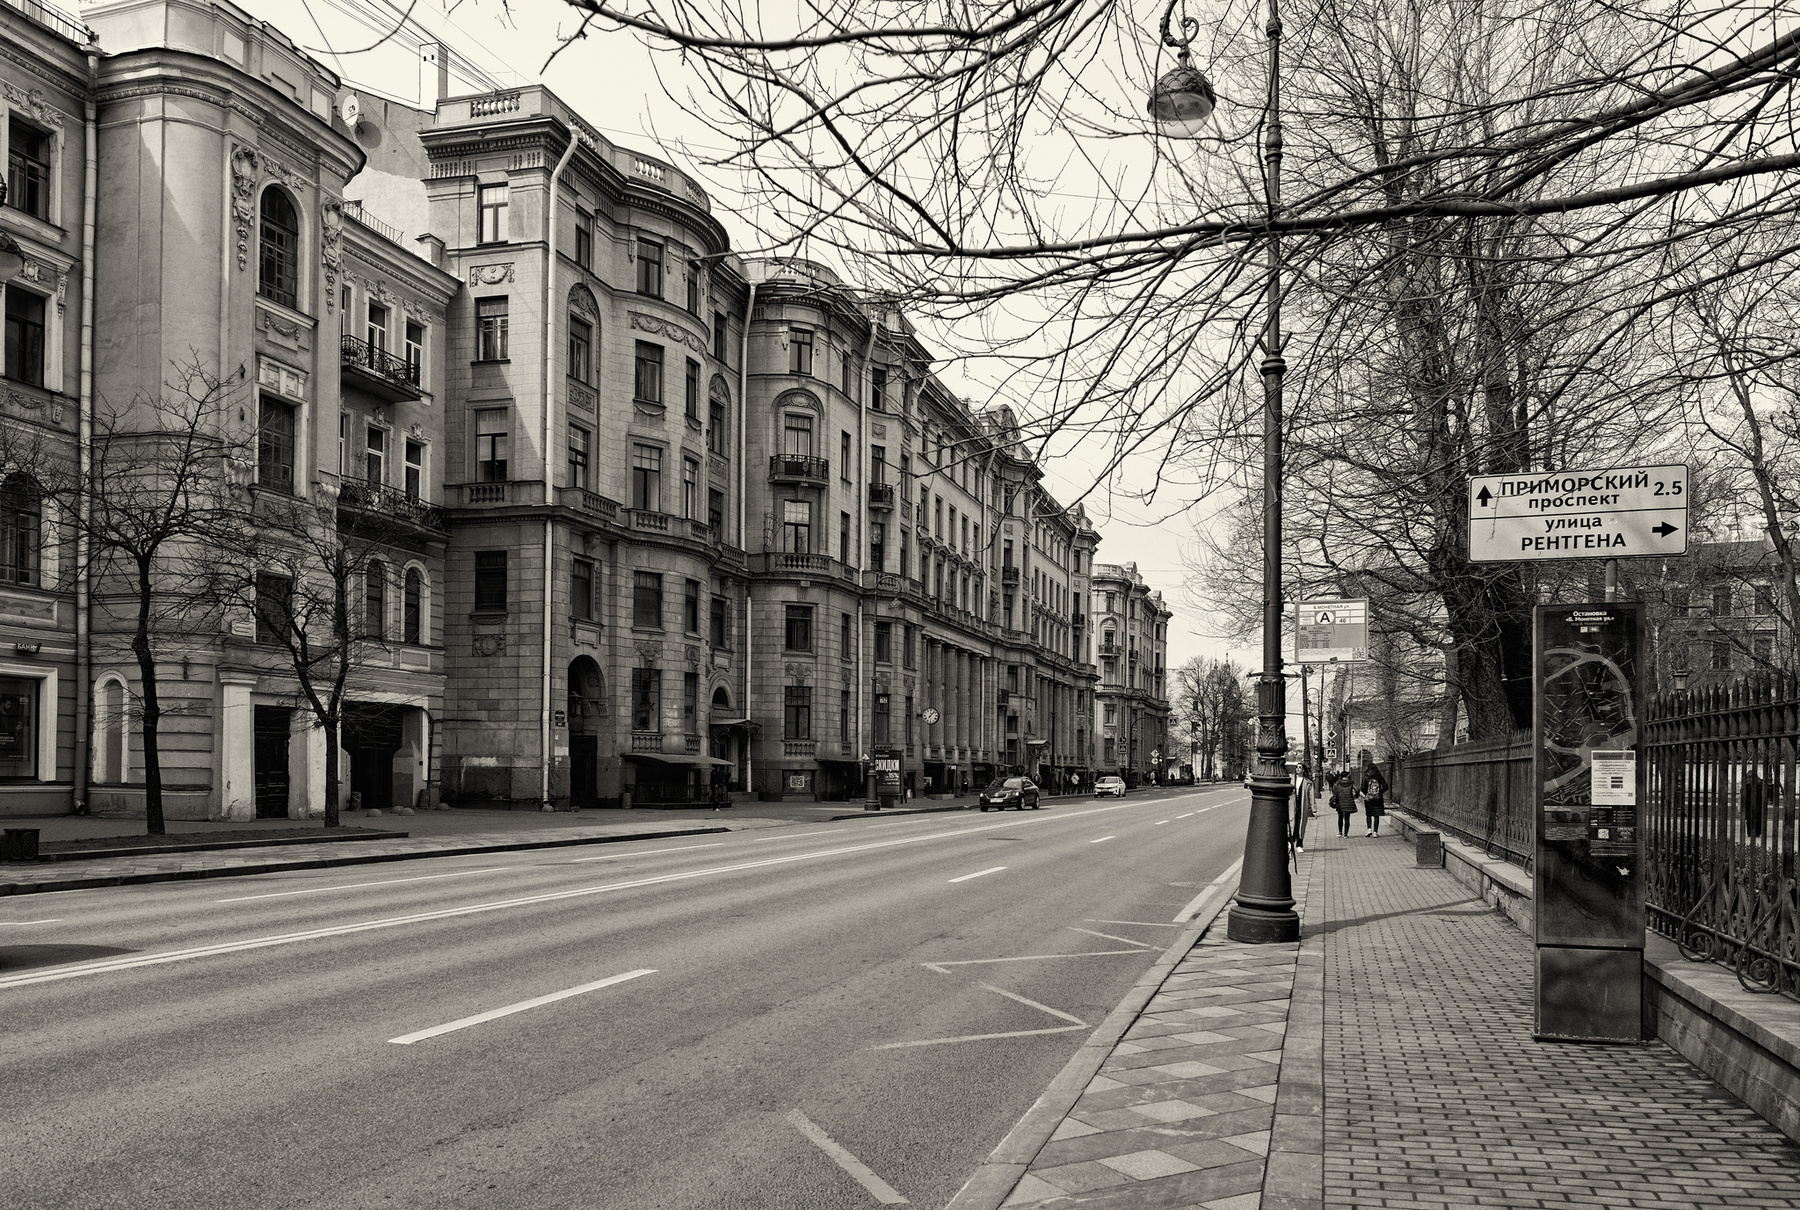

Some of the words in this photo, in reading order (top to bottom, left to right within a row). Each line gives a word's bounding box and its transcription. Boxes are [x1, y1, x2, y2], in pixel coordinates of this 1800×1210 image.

[1502, 470, 1649, 496] ПРИМОРСКИЙ
[1653, 480, 1683, 496] 2.5
[1528, 493, 1620, 512] проспект
[1545, 517, 1602, 533] улица
[1521, 533, 1627, 551] РЕНТГЕНА
